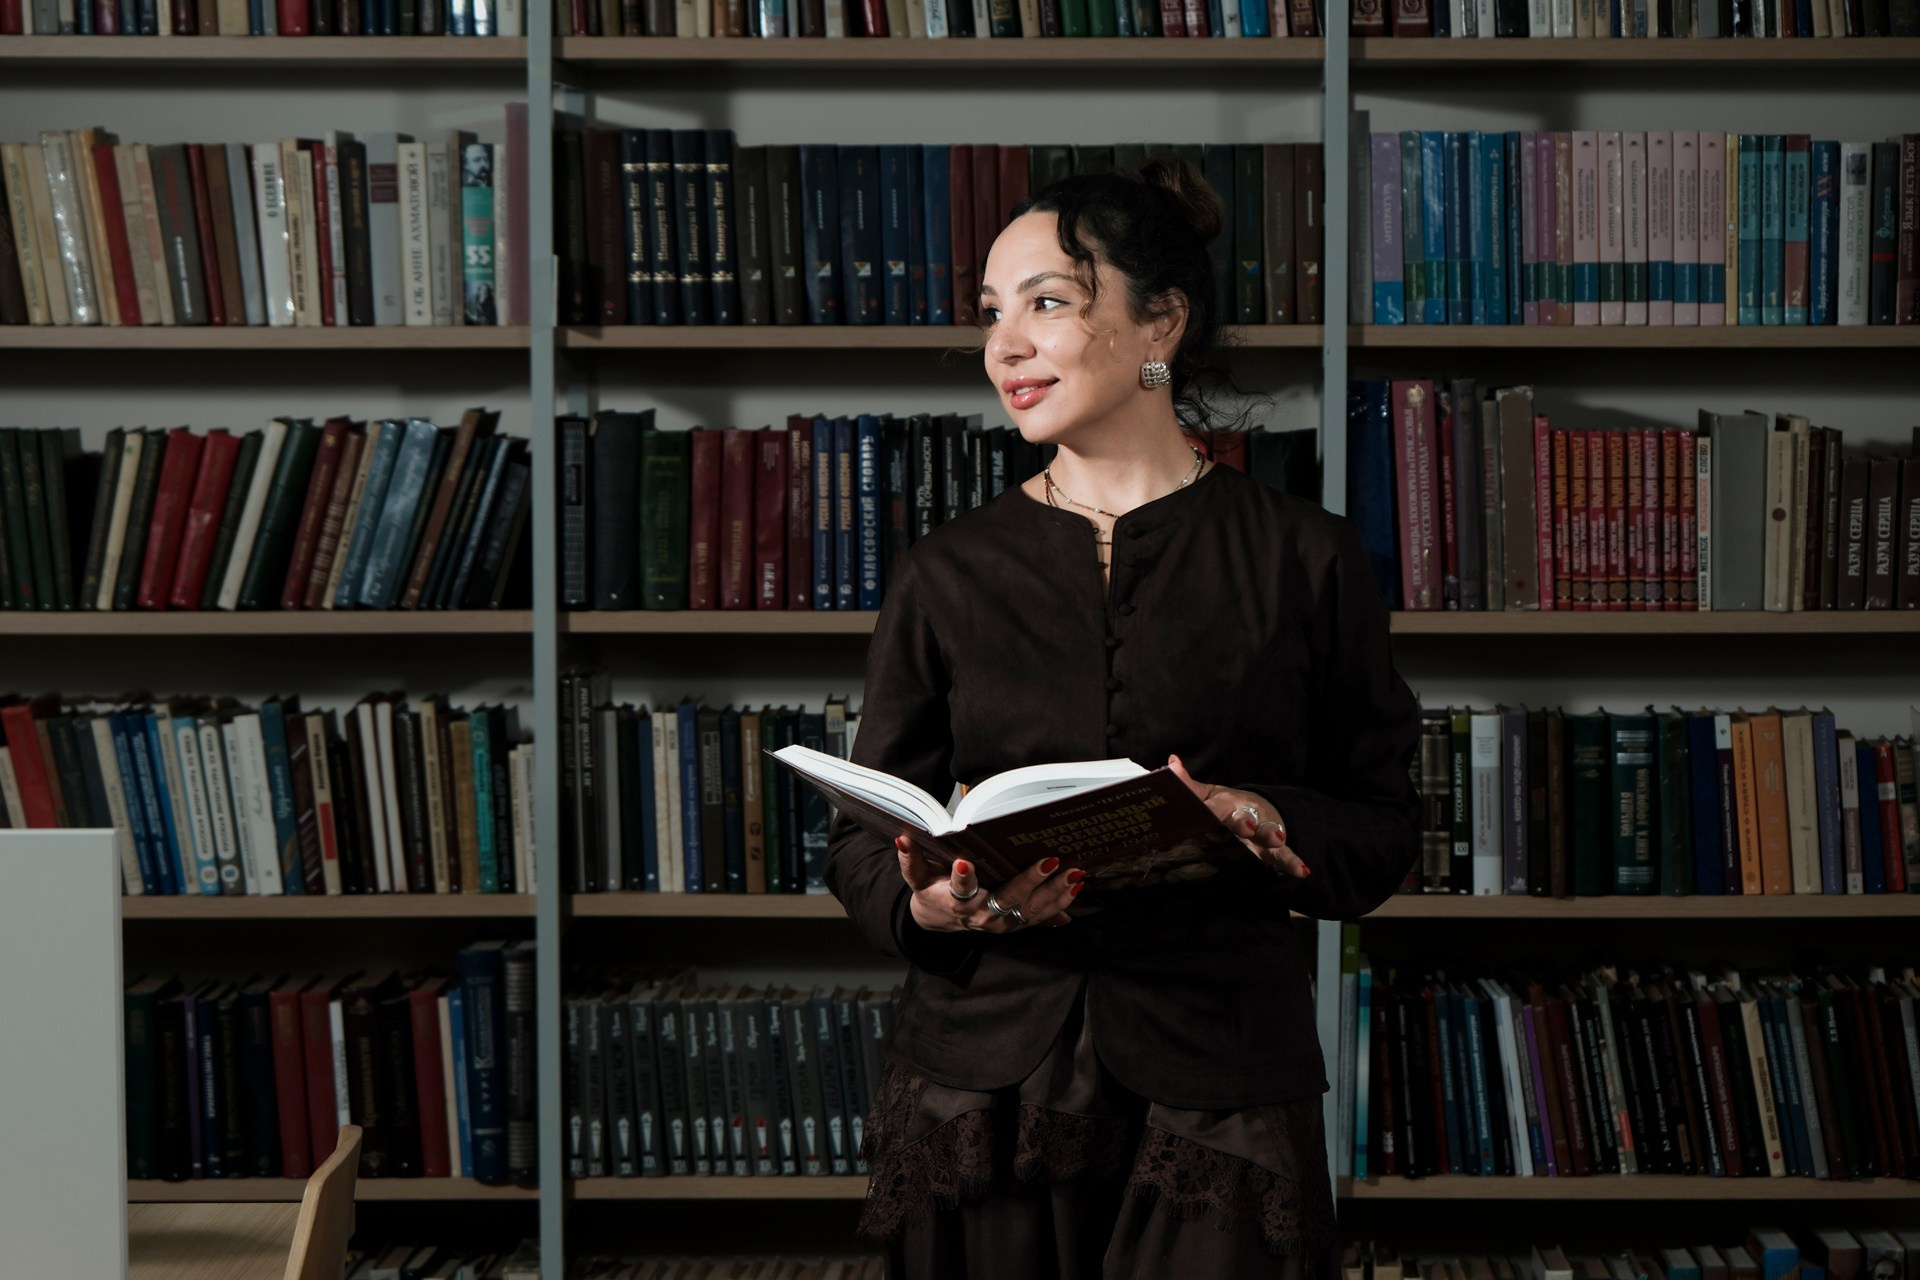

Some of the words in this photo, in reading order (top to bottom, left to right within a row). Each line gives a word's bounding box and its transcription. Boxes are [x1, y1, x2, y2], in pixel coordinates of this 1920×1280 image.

[406, 162, 424, 241] АХМАТОВОЙ
[411, 246, 424, 283] АННЕ
[413, 287, 424, 304] ОБ
[1769, 291, 1777, 305] 1
[1792, 290, 1801, 305] 2
[861, 435, 875, 491] СЛОВАРЬ
[923, 436, 932, 499] ОЧЕВИДНОСТИ
[917, 485, 925, 507] ПУТЬ
[1421, 491, 1433, 547] РУССКОГО
[1849, 497, 1863, 540] СЕРДЦА
[1877, 496, 1891, 538] СЕРДЦА
[861, 496, 876, 590] ФИЛОСОФСКИЙ
[1848, 542, 1861, 576] РАЗУМ
[1876, 541, 1890, 575] РАЗУМ
[1906, 542, 1920, 576] РАЗУМ
[1454, 752, 1464, 784] ЖАРГОН
[1454, 787, 1464, 822] РУССКИЙ
[1620, 792, 1634, 837] БОЛЬШАЯ
[1042, 813, 1152, 848] ВОЕННЫЙ
[1058, 822, 1153, 854] ОРКЕСТР
[1635, 830, 1649, 860] КНИГА
